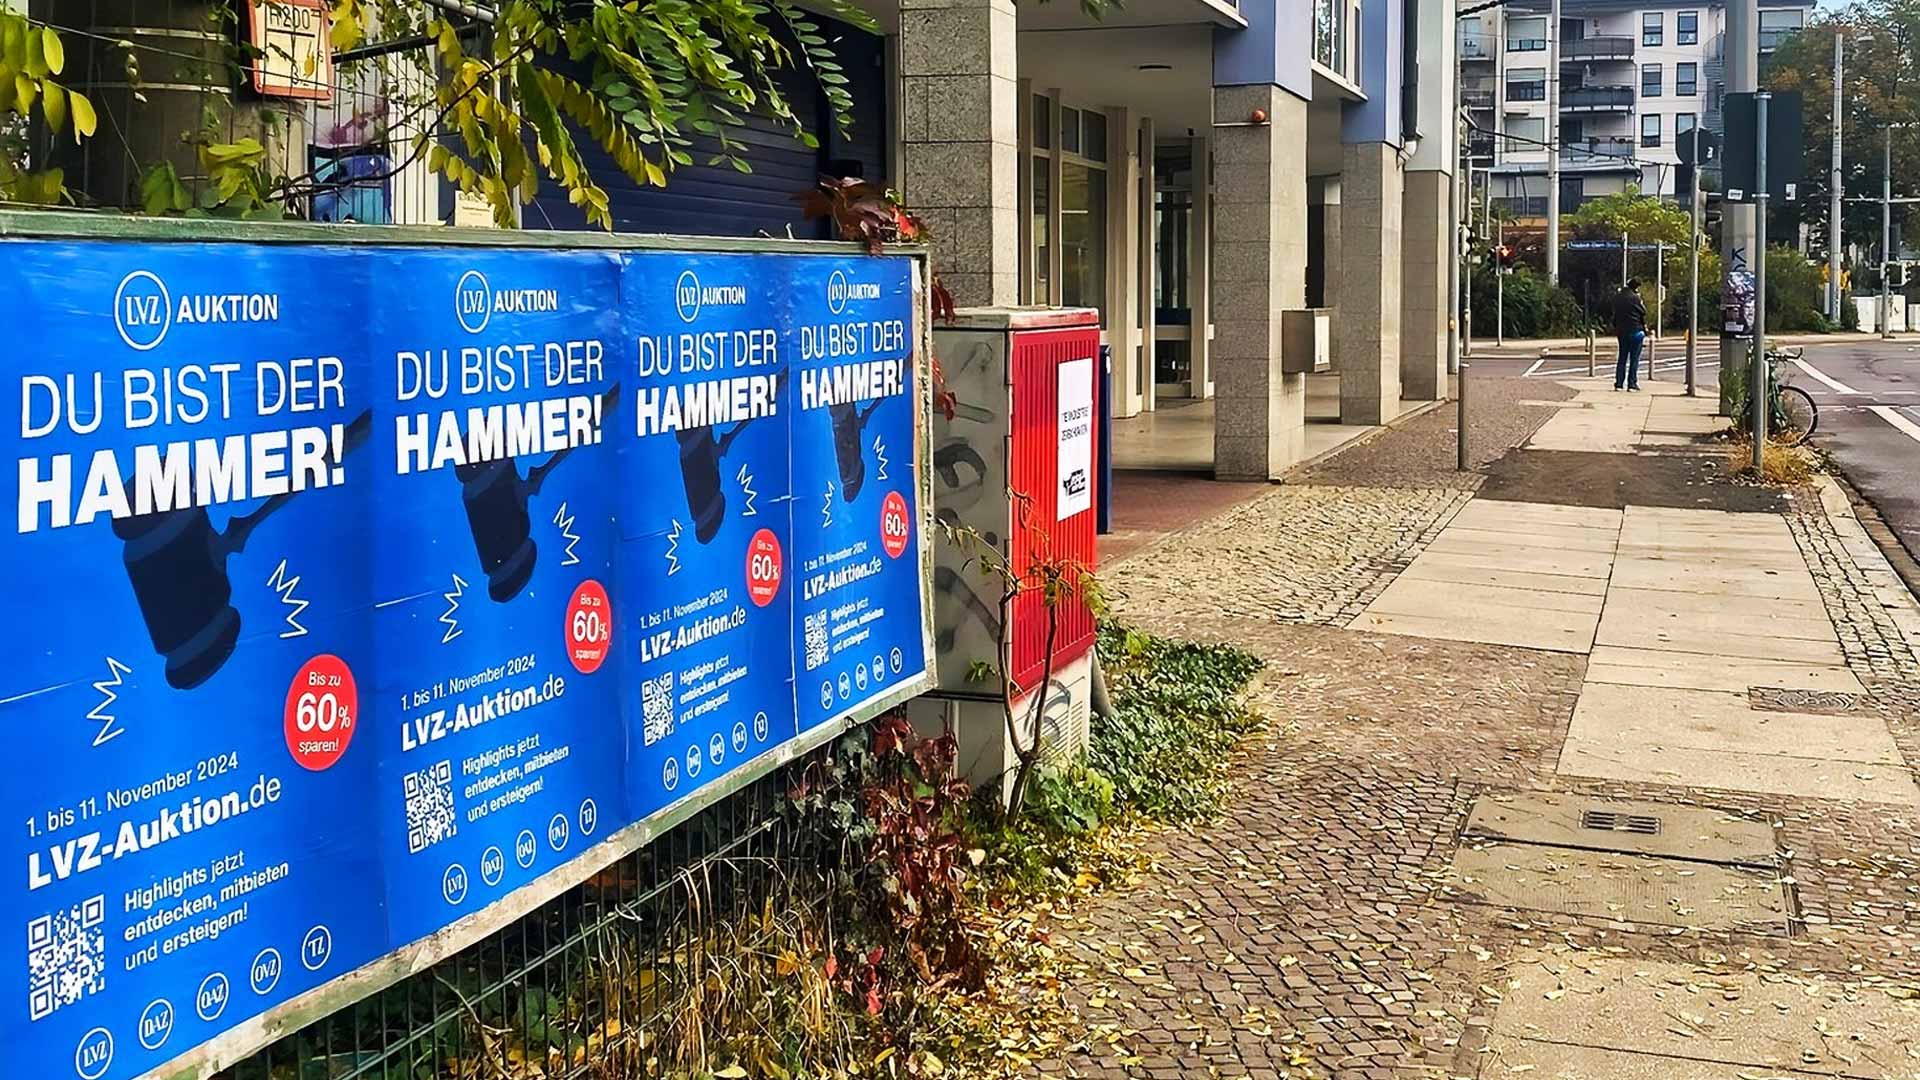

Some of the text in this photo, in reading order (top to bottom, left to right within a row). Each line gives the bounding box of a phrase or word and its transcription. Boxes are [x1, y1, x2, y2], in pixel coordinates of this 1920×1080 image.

[125, 295, 278, 325] LVZ AUKTION
[463, 289, 558, 314] LVZ AUKTION
[681, 286, 746, 307] LVZ AUKTION
[846, 284, 880, 300] AUKTION
[639, 329, 777, 377] DU BIST DER
[801, 319, 903, 360] DU BIST DER
[397, 340, 603, 401] DU BIST DER
[801, 359, 903, 411] HAMMER!
[21, 357, 345, 438] DU BIST DER
[637, 374, 777, 437] HAMMER!
[396, 394, 602, 475] HAMMER!
[18, 424, 345, 533] HAMMER!
[674, 594, 709, 619] November
[709, 587, 728, 607] 2024
[804, 558, 882, 601] LVZ-Auktion.de
[573, 610, 608, 643] 60%
[641, 605, 746, 663] LVZ-Auktion.de
[308, 671, 341, 687] Bis zu
[401, 654, 536, 711] 1. bis 11. November 2024
[296, 692, 350, 733] 60%
[401, 674, 565, 751] LVZ-Auktion.de
[298, 739, 339, 757] sparen!
[462, 733, 540, 776] Highlights jetzt
[464, 744, 569, 798] entdecken, mitbieten
[26, 751, 239, 837] 1. bis 11. November 2024
[468, 776, 544, 822] und ersteigern!
[28, 774, 282, 890] LVZ-Auktion.de
[124, 850, 245, 912] Highlights jetzt
[124, 860, 289, 942] entdecken, mitbieten
[447, 873, 463, 895] LVZ
[125, 903, 248, 971] und ersteigern!
[82, 1040, 108, 1066] LVZ
[255, 958, 277, 982] OVZ
[308, 935, 325, 959] TZ
